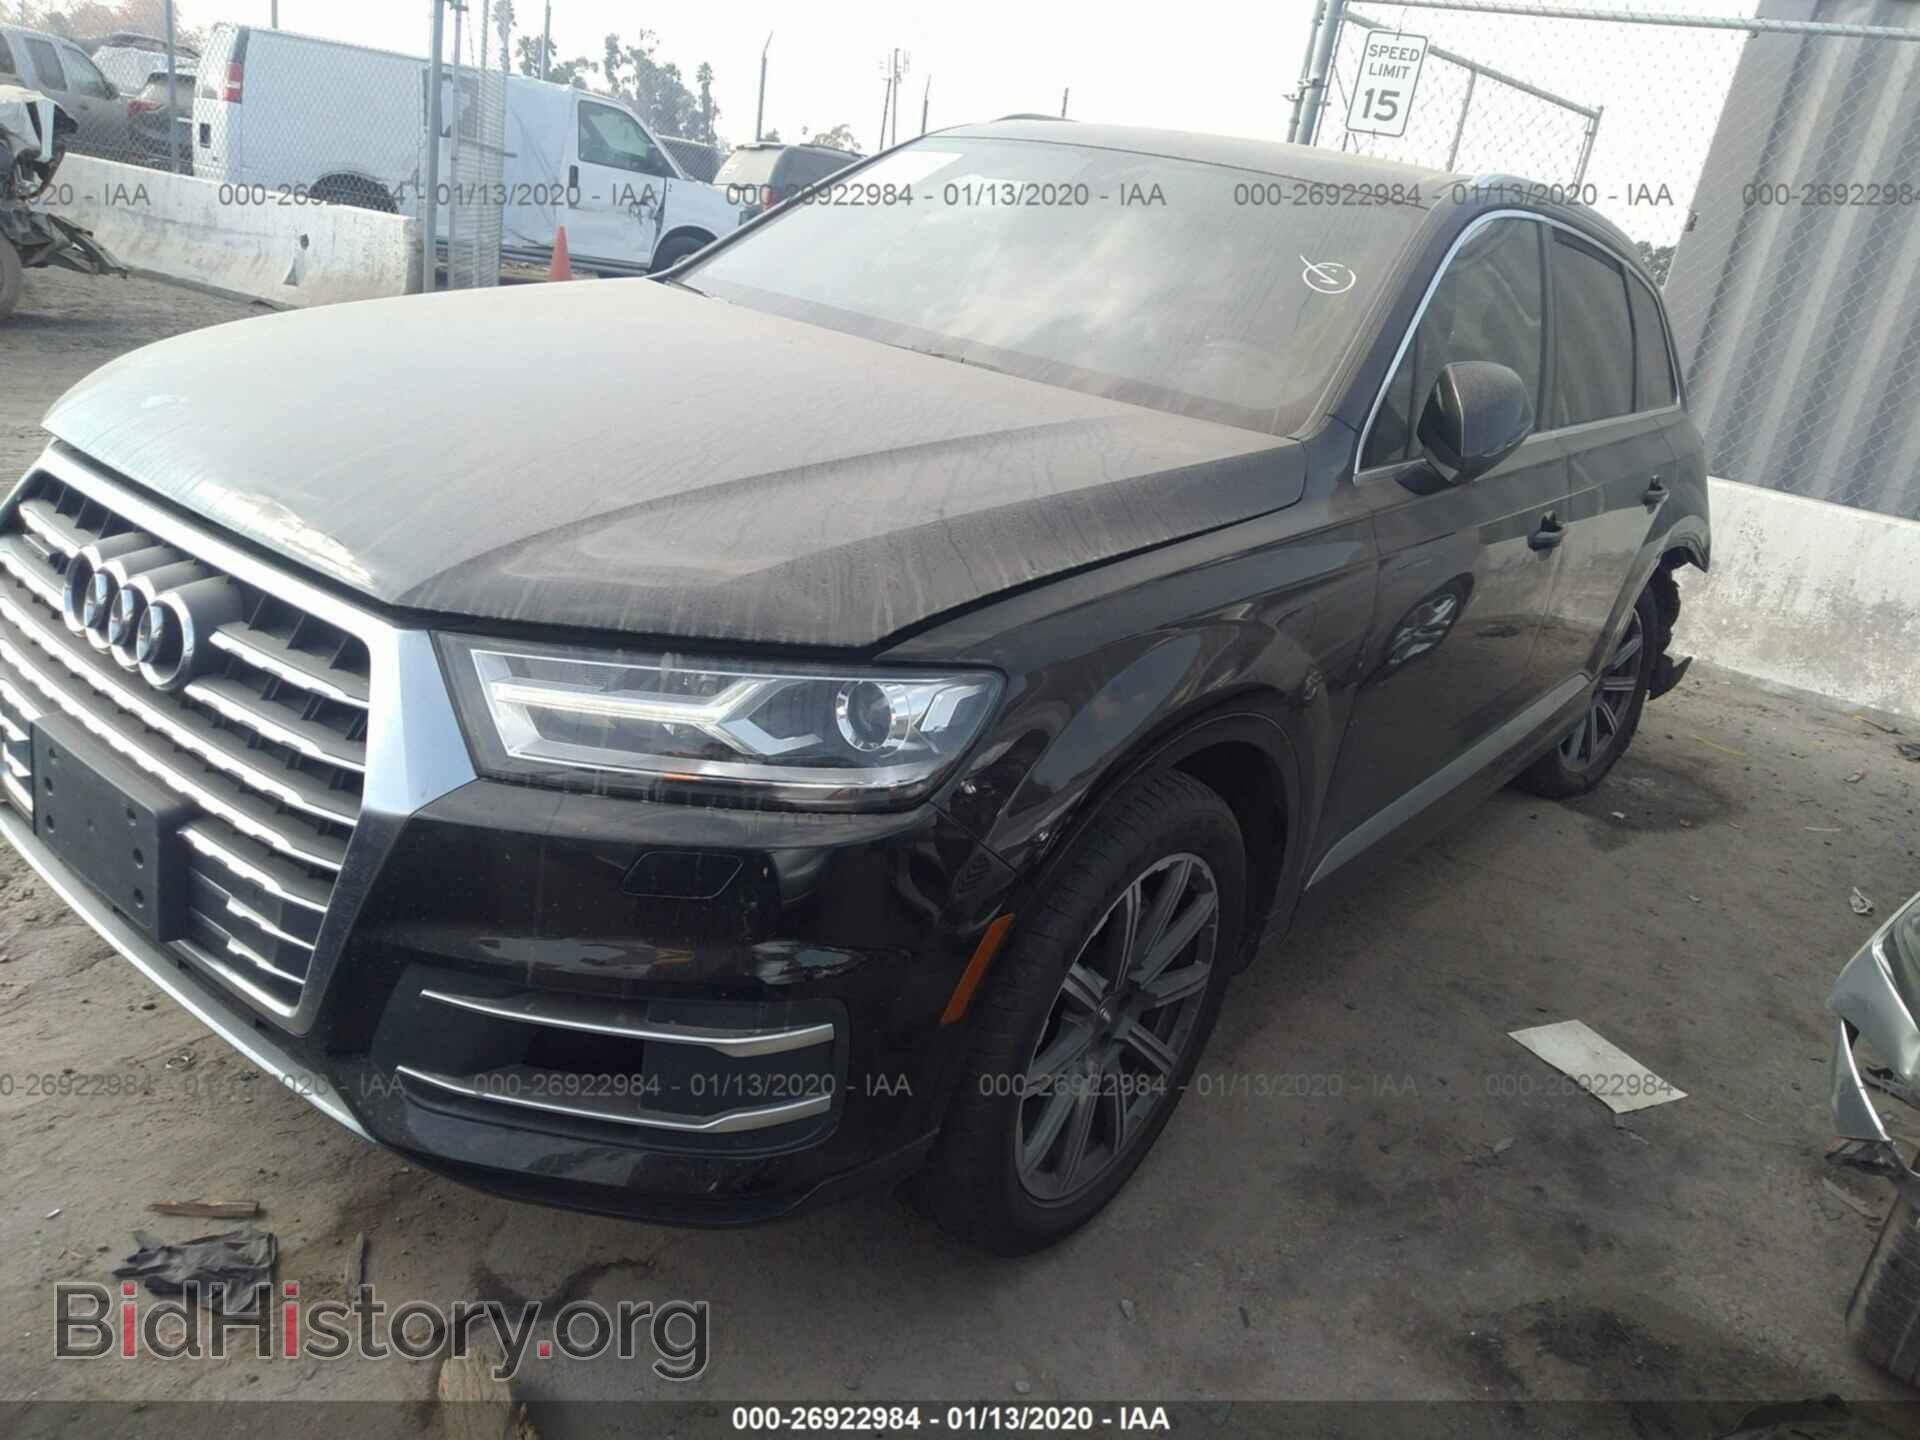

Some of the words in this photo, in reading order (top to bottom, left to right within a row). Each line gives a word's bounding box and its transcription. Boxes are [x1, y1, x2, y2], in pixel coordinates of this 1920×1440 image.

[1368, 44, 1420, 62] SPEED
[1368, 62, 1411, 79] LIMIT
[1362, 87, 1400, 121] 15
